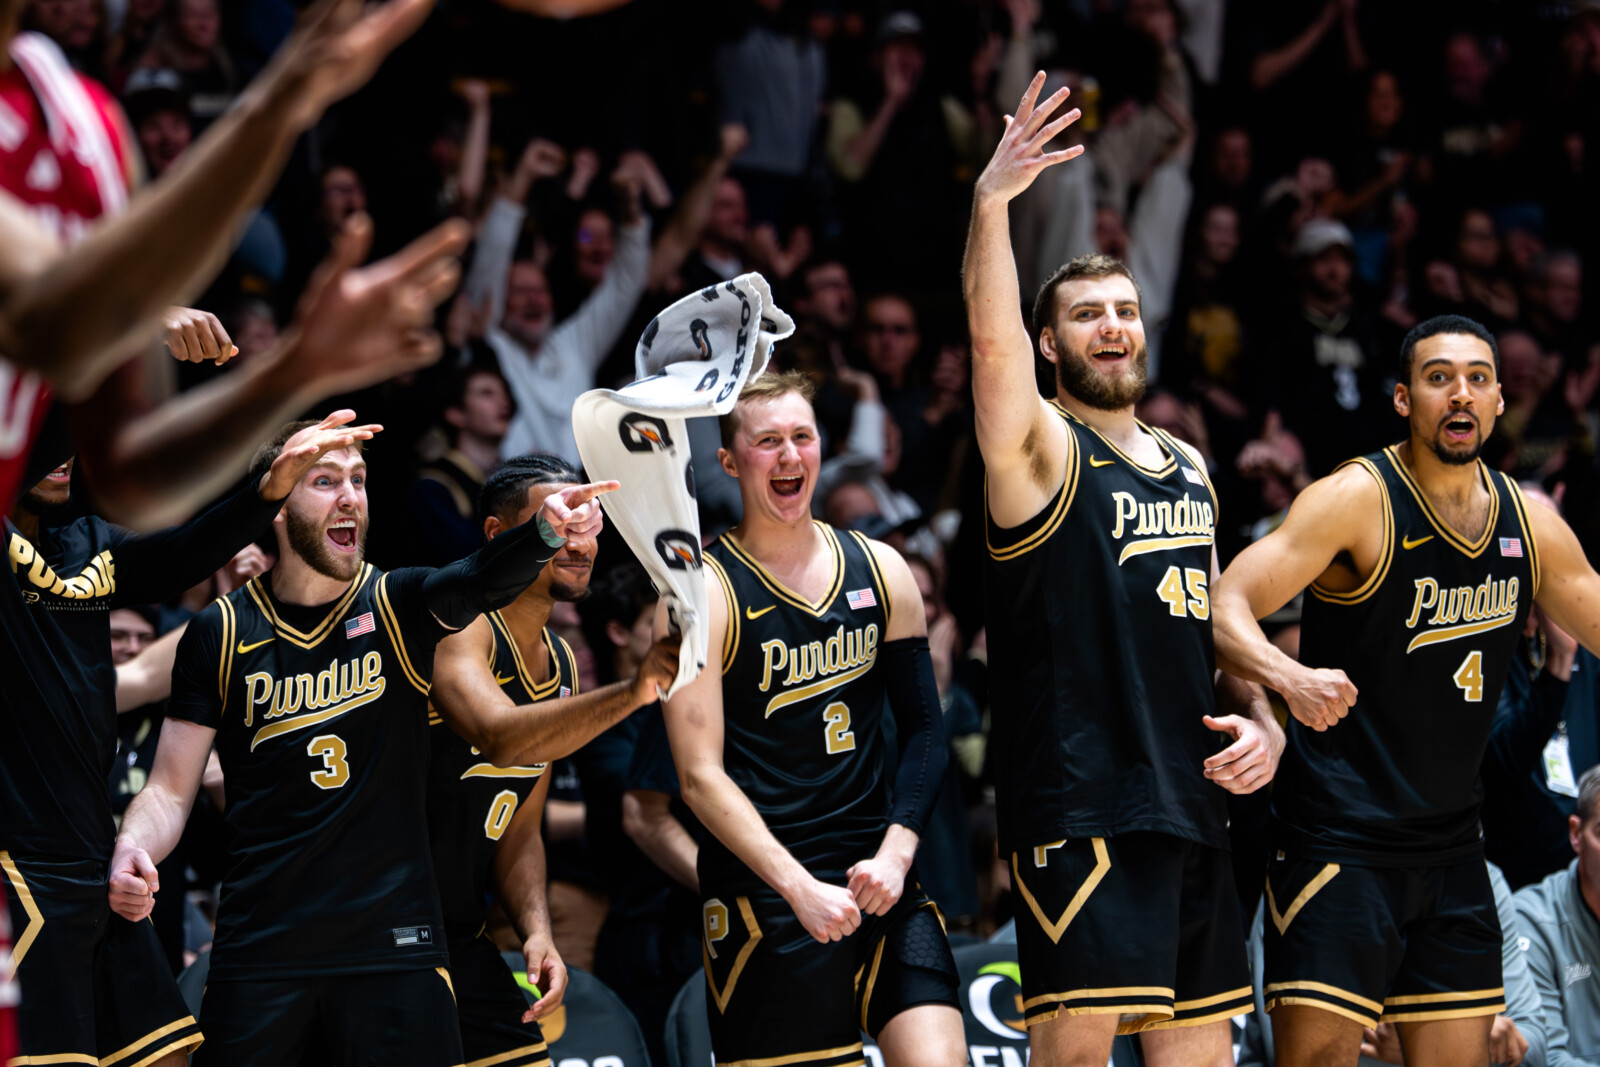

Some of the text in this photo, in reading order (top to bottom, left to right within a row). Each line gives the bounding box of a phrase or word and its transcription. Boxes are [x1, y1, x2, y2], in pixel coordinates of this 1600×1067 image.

[1111, 491, 1215, 539] Purdue
[1156, 565, 1210, 620] 45
[1405, 574, 1520, 629] Purdue
[758, 622, 880, 693] Purdue
[1453, 650, 1483, 702] 4
[244, 650, 387, 728] Purdue
[822, 701, 857, 755] 2
[306, 733, 351, 790] 3
[484, 789, 518, 841] 0
